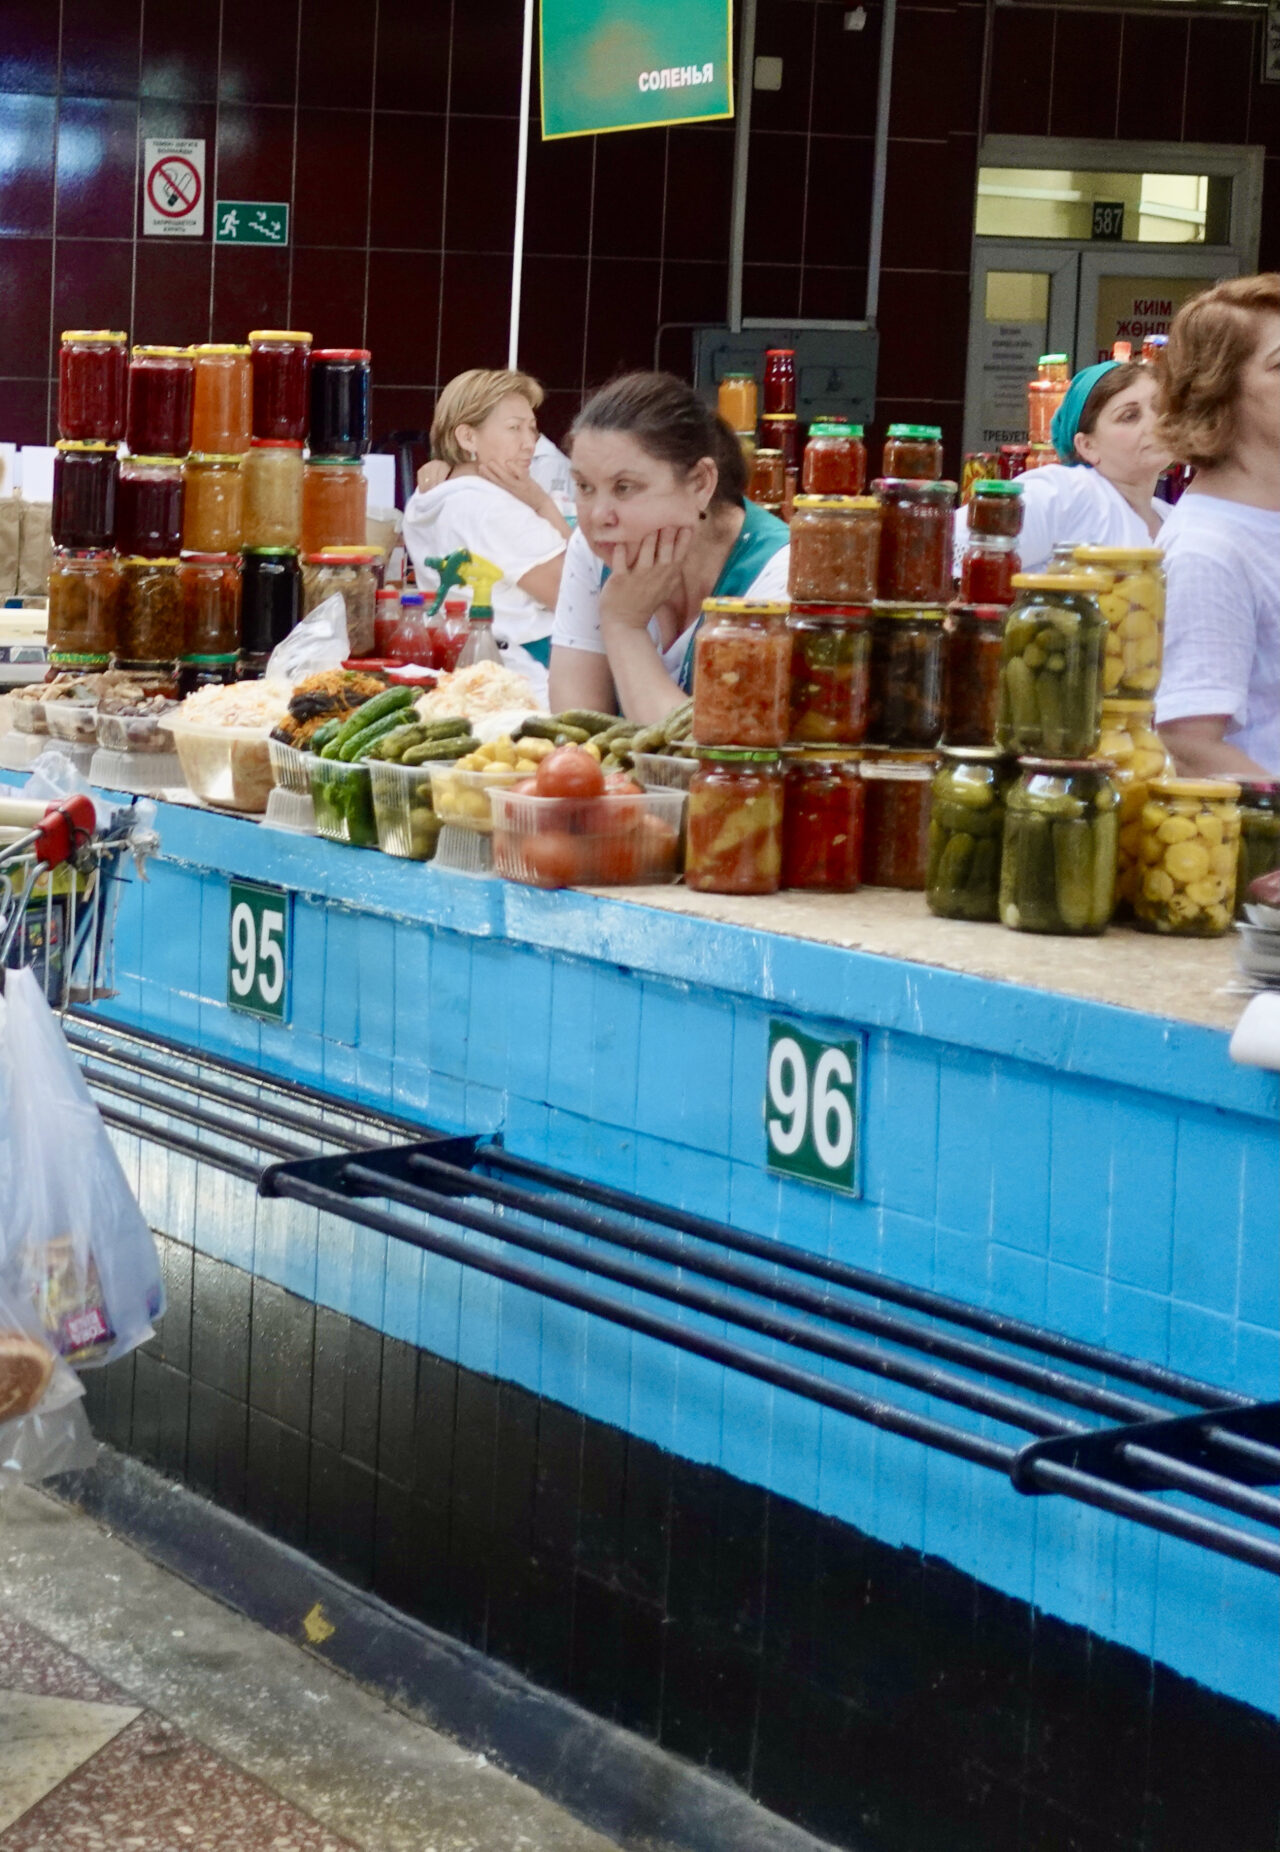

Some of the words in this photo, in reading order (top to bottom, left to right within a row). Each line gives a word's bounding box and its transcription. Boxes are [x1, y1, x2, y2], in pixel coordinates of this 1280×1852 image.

[638, 62, 714, 92] СОЛЕНЬЯ
[1093, 207, 1122, 234] 587
[1133, 300, 1173, 316] КИІМ
[231, 902, 284, 1004] 95
[768, 1037, 853, 1168] 96
